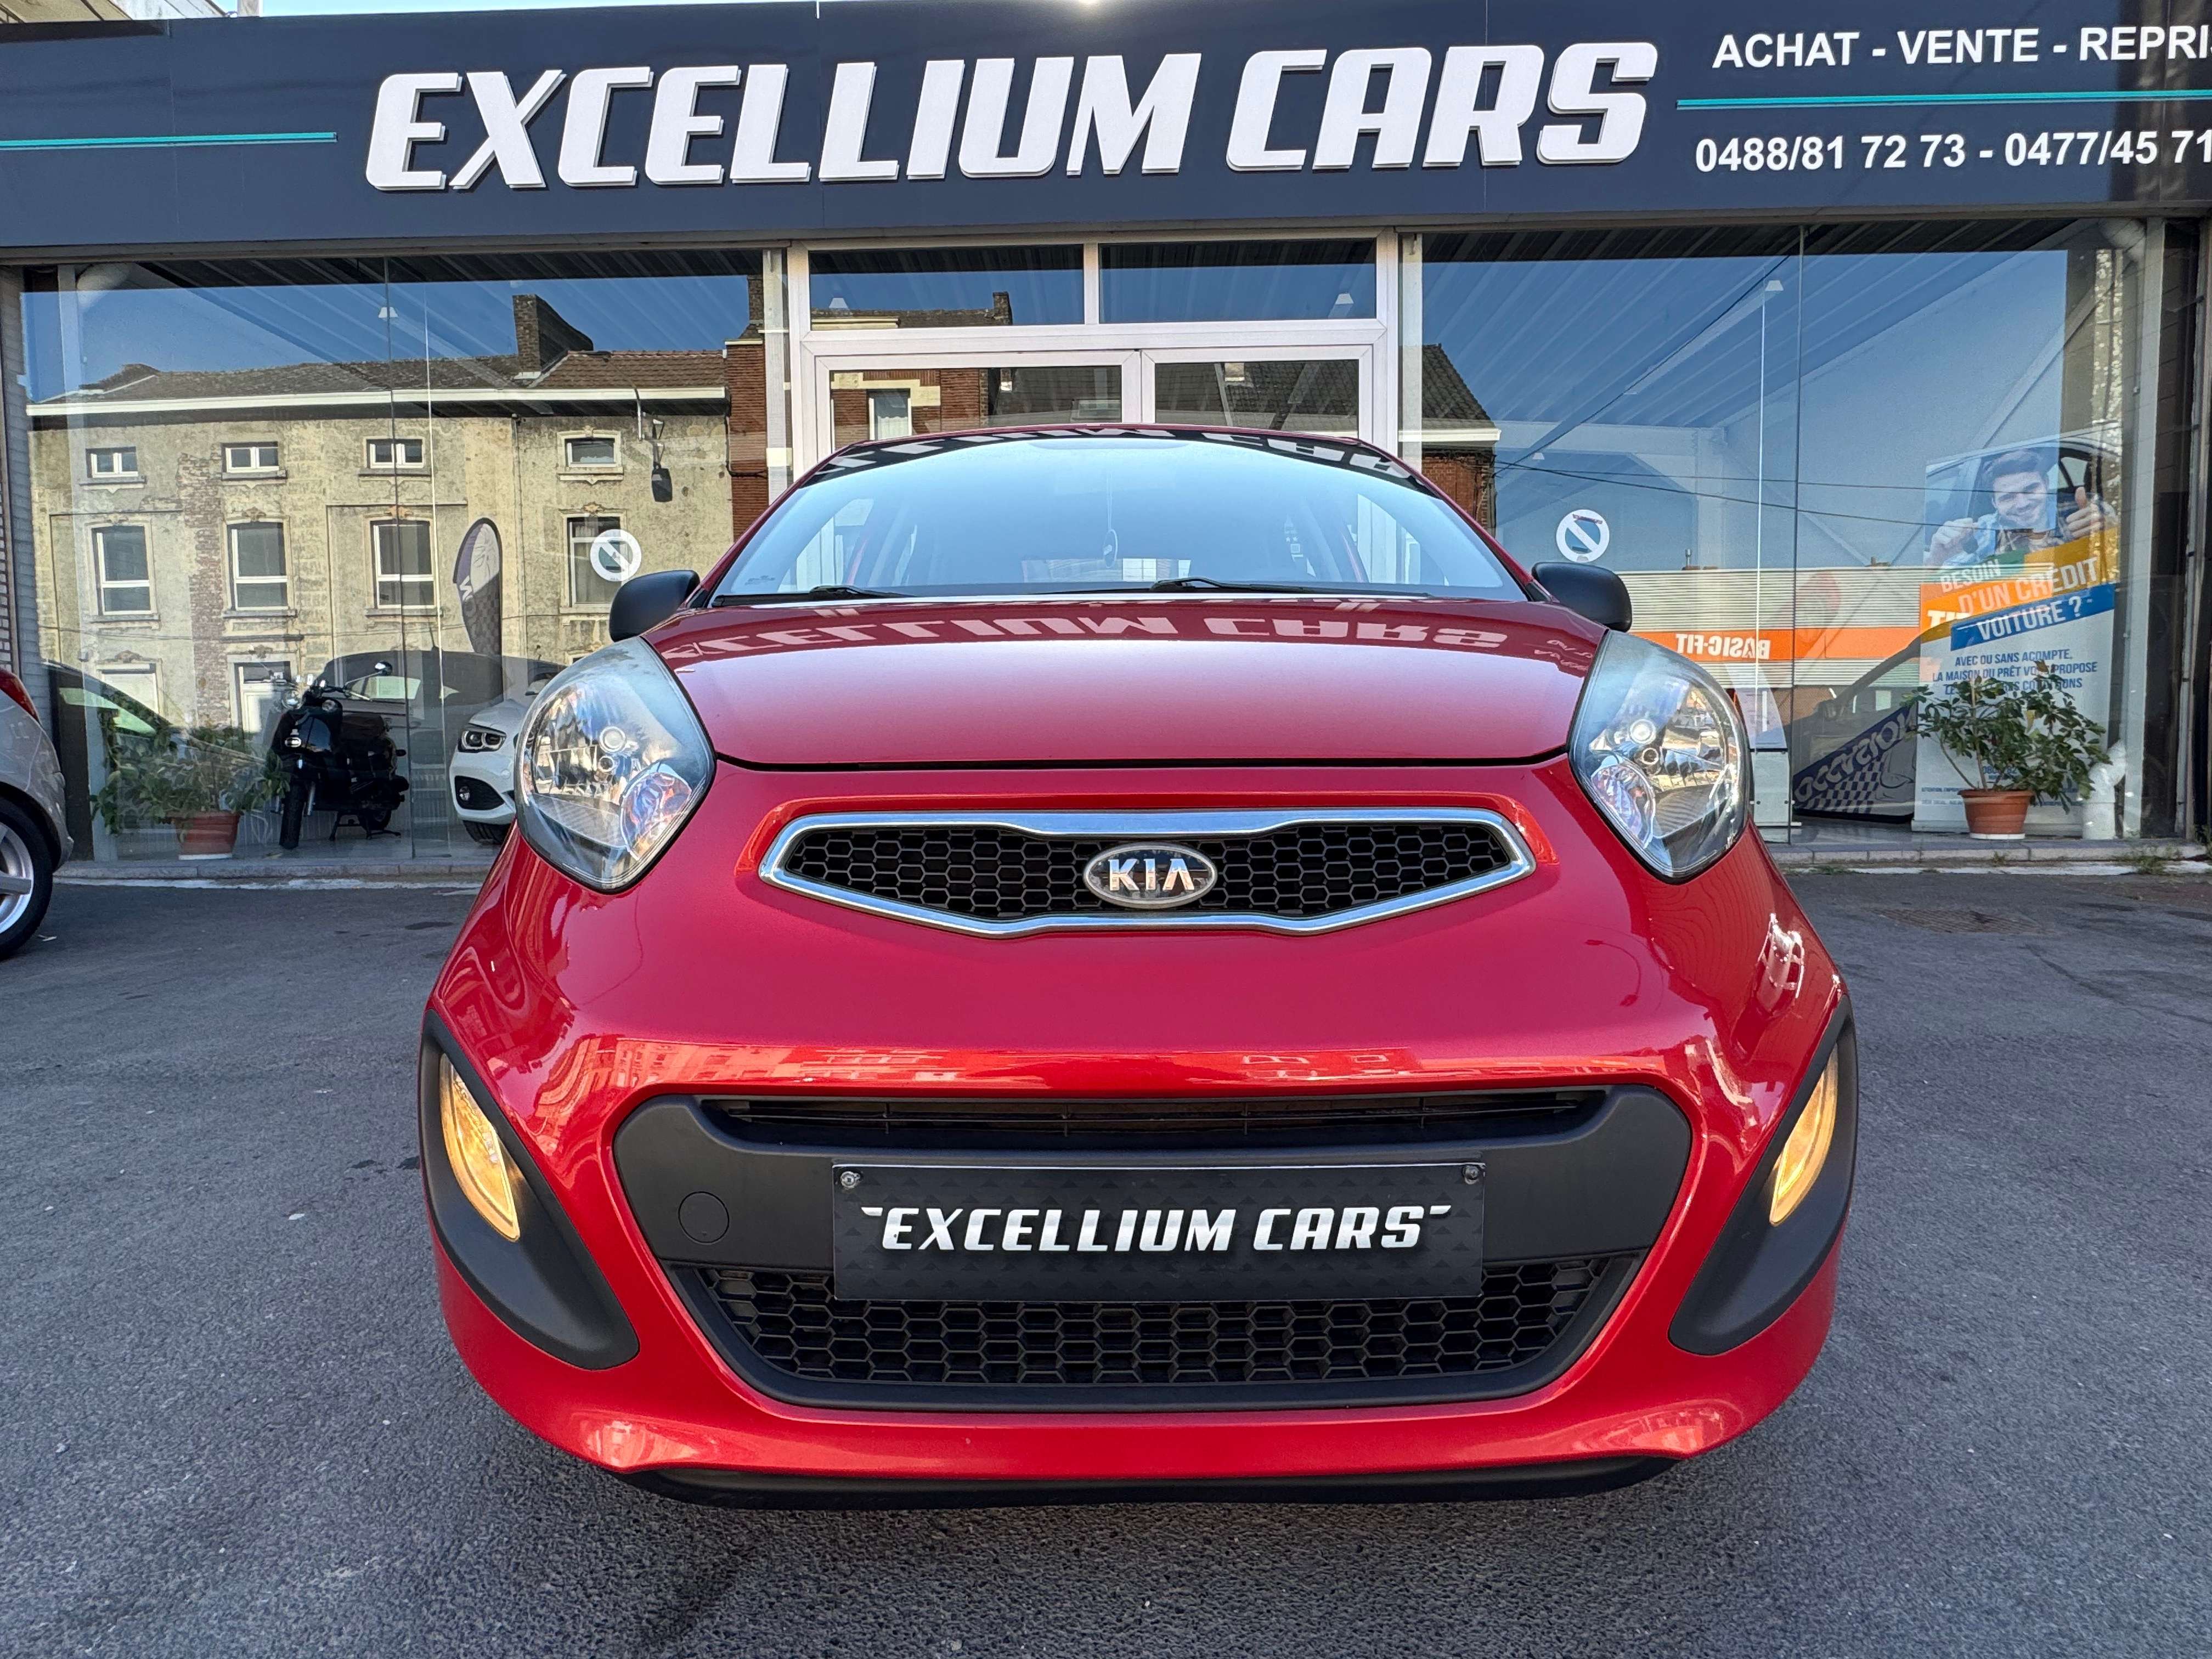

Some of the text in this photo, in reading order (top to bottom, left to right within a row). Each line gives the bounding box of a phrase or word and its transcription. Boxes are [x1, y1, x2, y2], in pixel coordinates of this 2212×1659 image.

[1712, 32, 1860, 68] ACHAT
[1897, 28, 2039, 64] VENTE
[2079, 25, 2212, 61] REPRI
[365, 42, 1659, 192] EXCELLIUM CARS
[1696, 136, 1843, 172] 0488/81
[1861, 135, 1906, 168] 72
[1920, 134, 1965, 167] 73
[2005, 131, 2158, 166] 0477/45
[2171, 129, 2212, 163] 71
[1941, 558, 2001, 594] BESOIN
[1958, 583, 2011, 615] D'UN
[1977, 601, 2067, 640] VOITURE
[1932, 672, 1943, 682] LA
[1945, 670, 1981, 681] MAISON
[1983, 668, 1995, 679] DU
[1997, 664, 2021, 678] PRÊT
[2023, 664, 2051, 676] VO
[1955, 656, 1978, 667] AVEC
[1980, 654, 1993, 665] OU
[1995, 652, 2019, 664] SANS
[1108, 858, 1195, 891] KIA
[882, 1205, 1425, 1252] EXCELLIUM CARS
